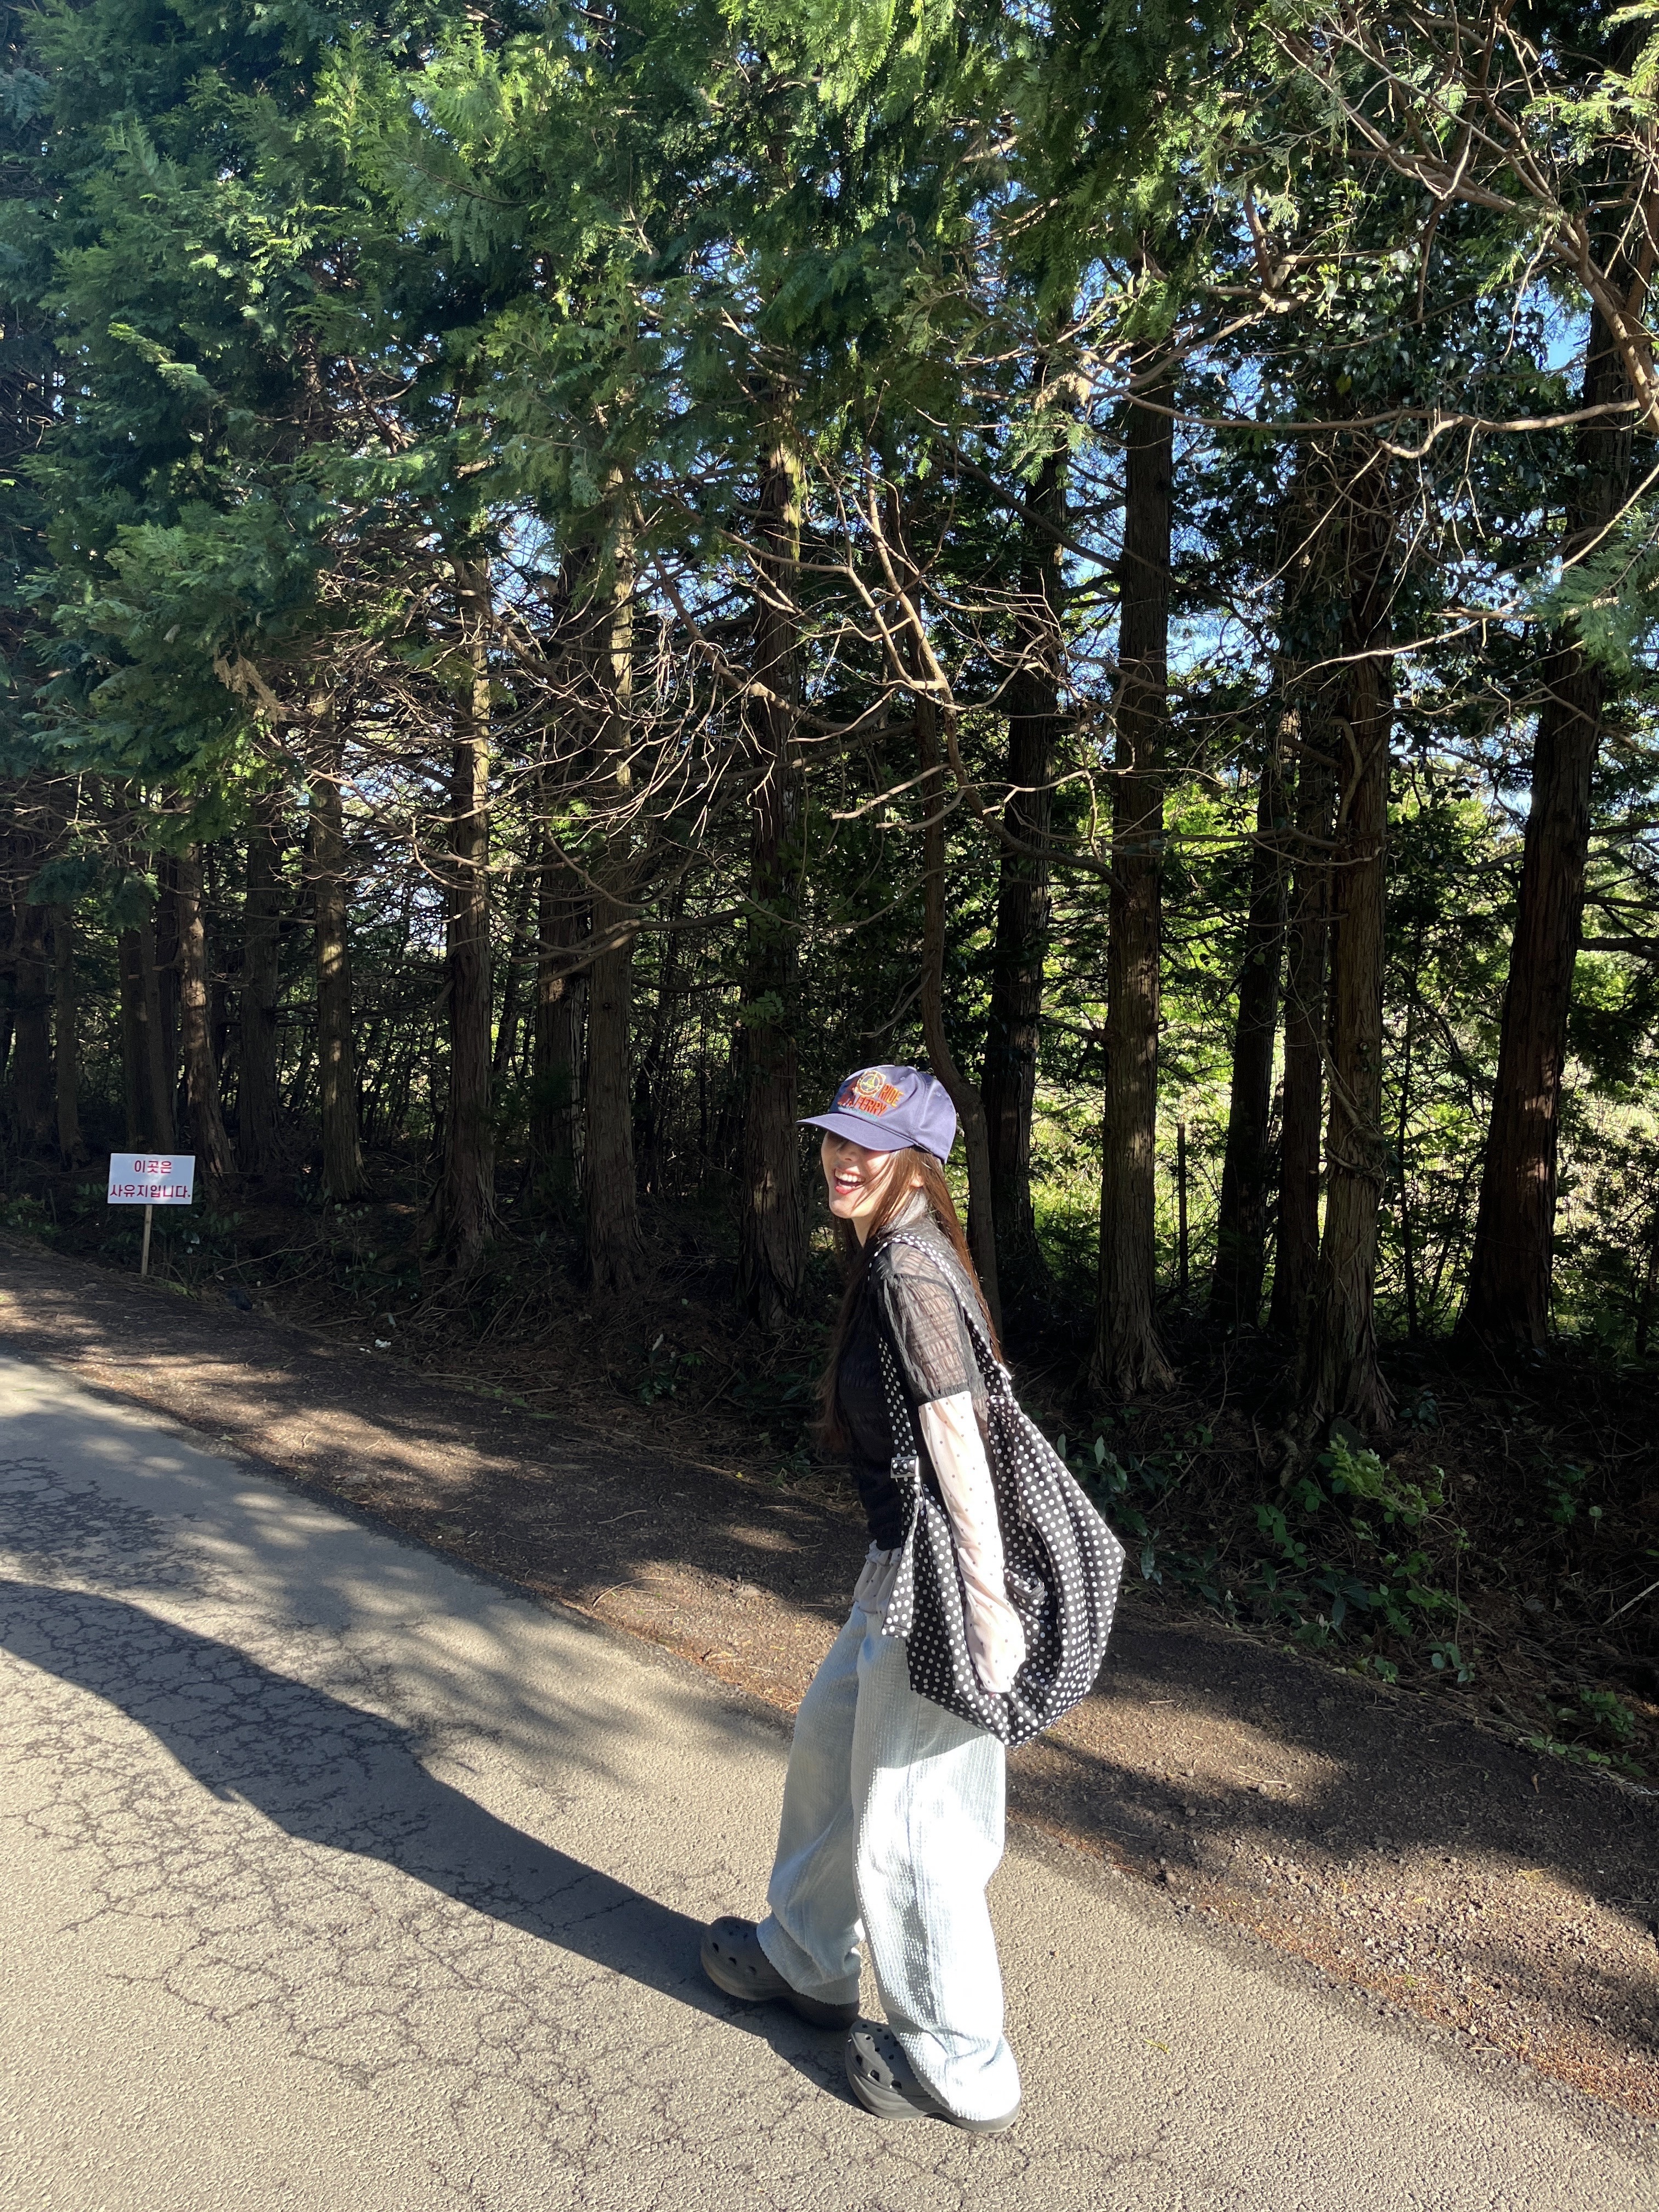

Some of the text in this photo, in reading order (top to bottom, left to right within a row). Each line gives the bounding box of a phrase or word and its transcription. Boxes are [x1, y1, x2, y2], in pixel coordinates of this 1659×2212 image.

[878, 1083, 904, 1108] RIDE
[854, 1096, 888, 1118] FERRY
[134, 1160, 172, 1174] 이곳은
